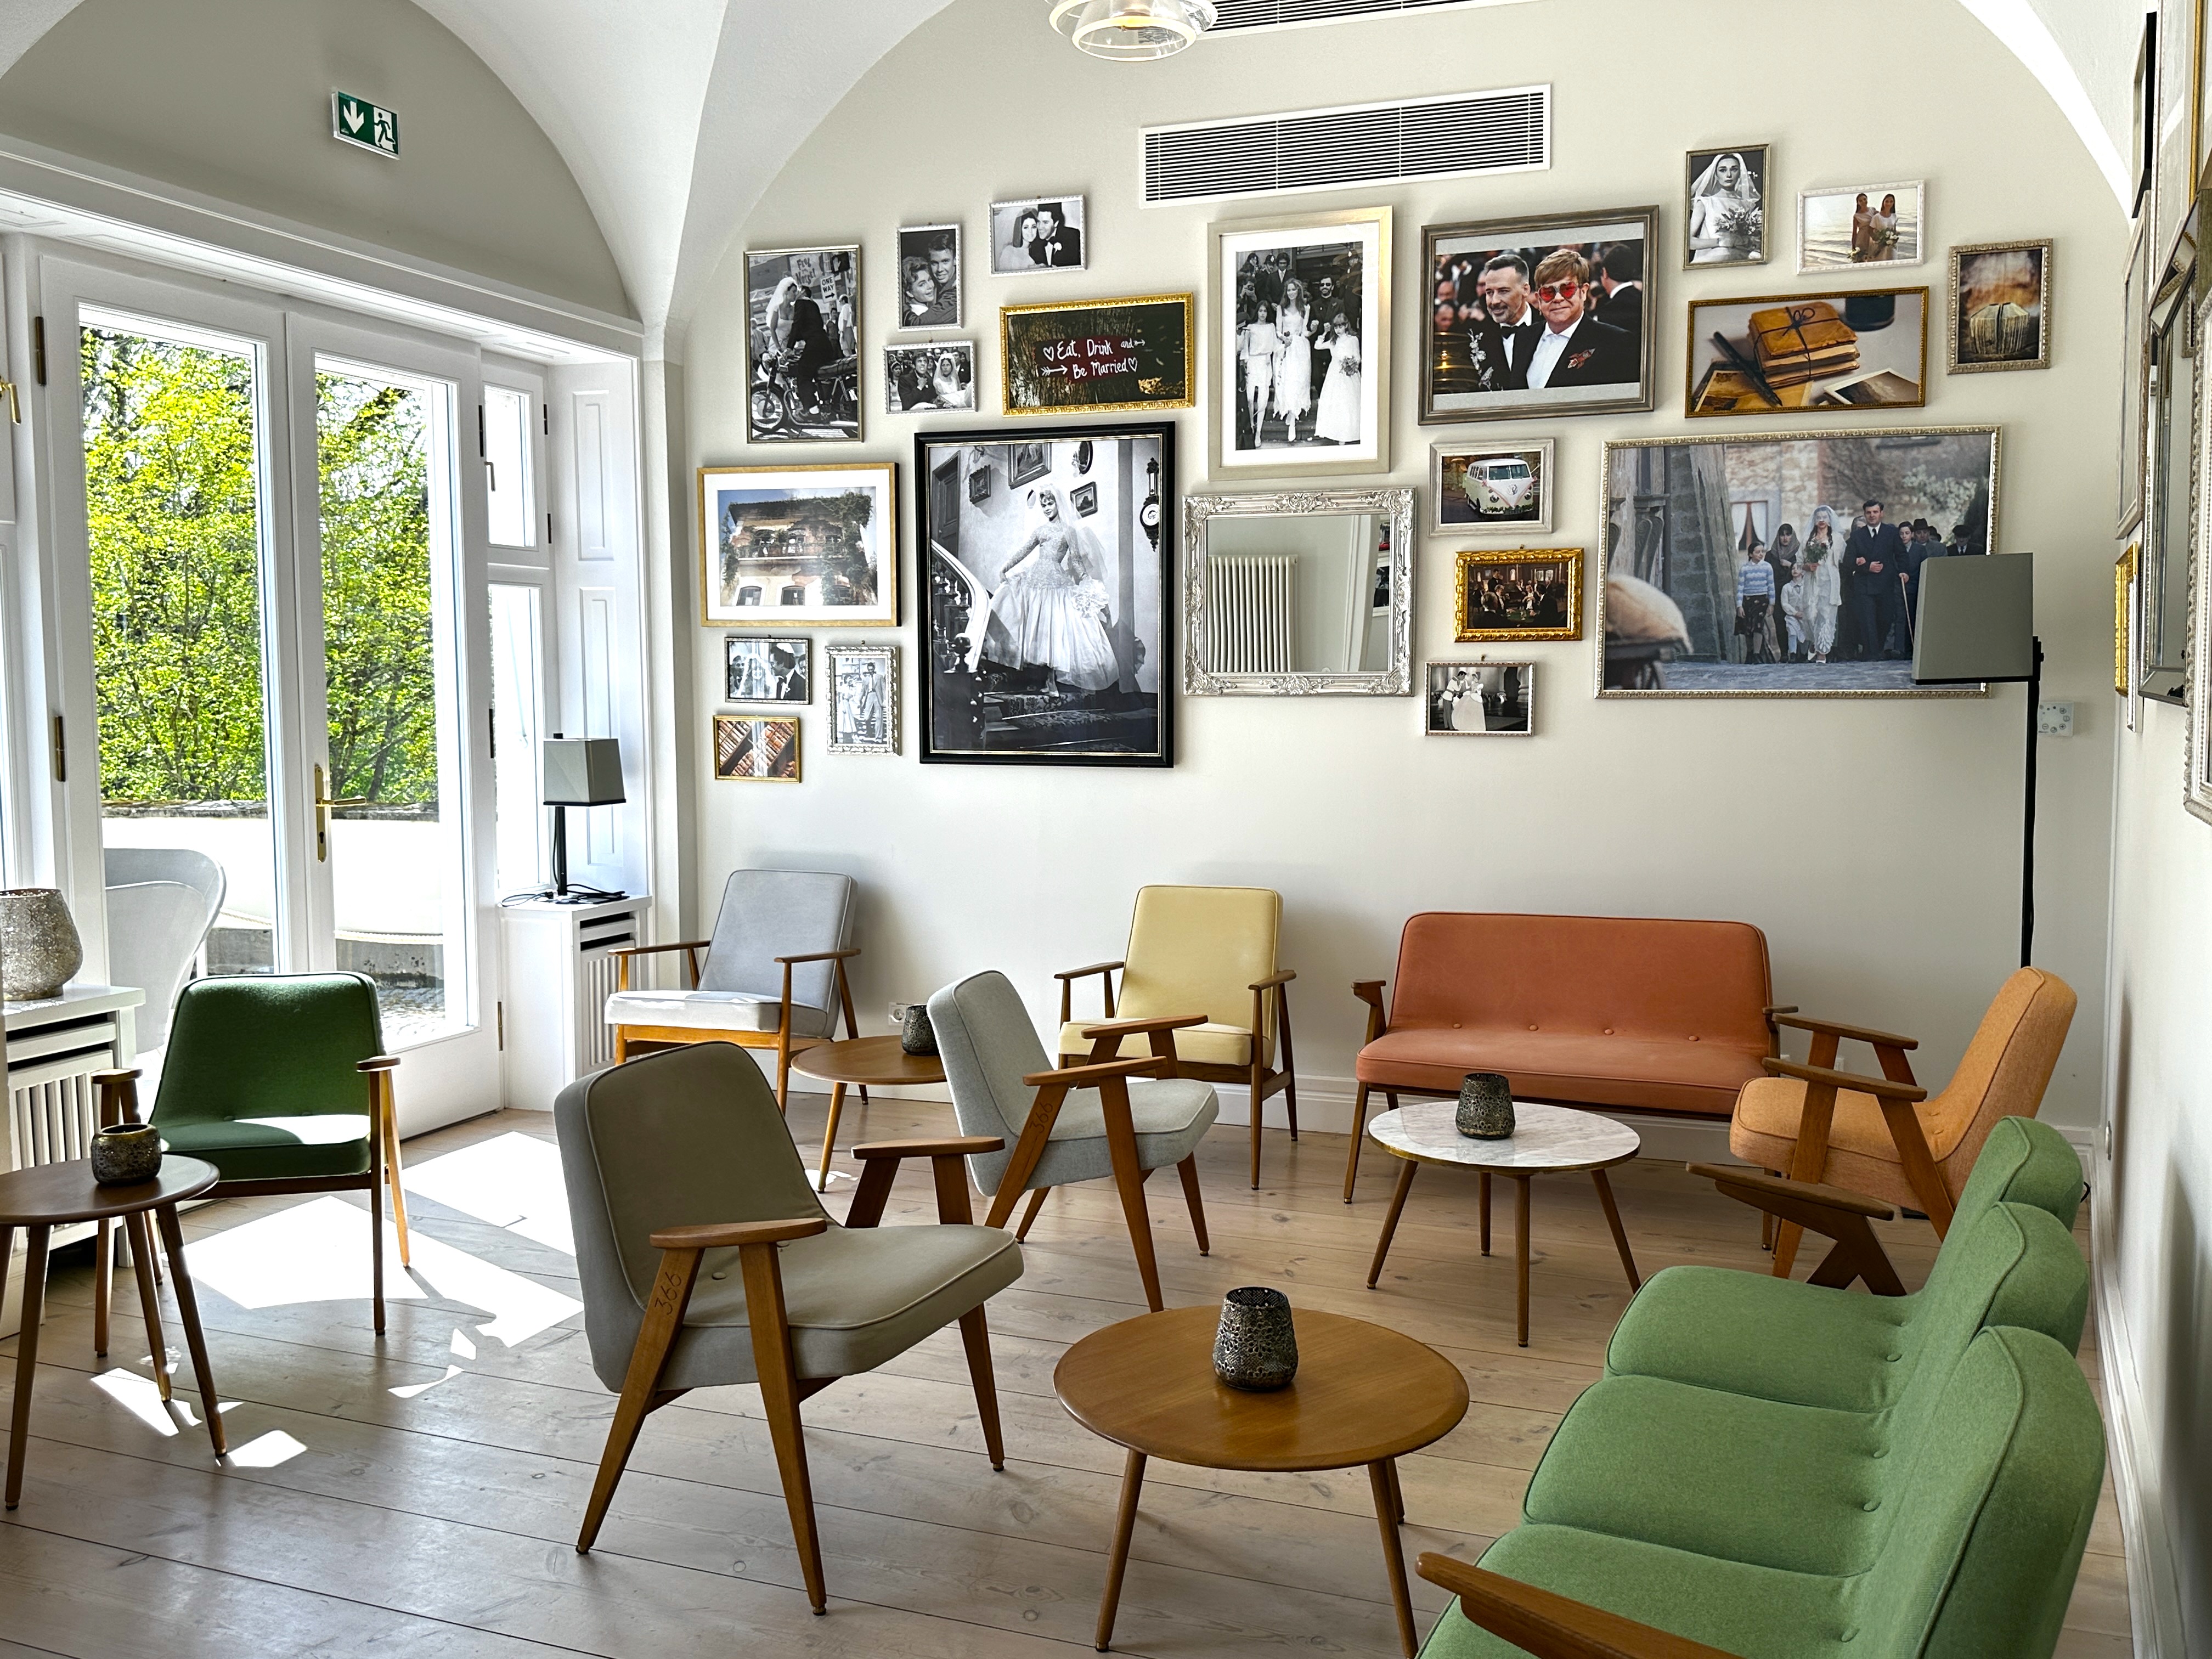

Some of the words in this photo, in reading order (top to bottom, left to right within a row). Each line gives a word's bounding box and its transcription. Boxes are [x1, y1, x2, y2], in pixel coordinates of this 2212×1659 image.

[822, 276, 833, 286] ONE
[822, 284, 834, 293] WAY
[1057, 340, 1081, 360] Eat,
[1087, 339, 1113, 357] Drink
[1120, 338, 1134, 349] and
[1073, 364, 1087, 379] Be
[1091, 358, 1128, 376] Married
[1029, 1101, 1053, 1133] 366
[654, 1271, 682, 1316] 366
